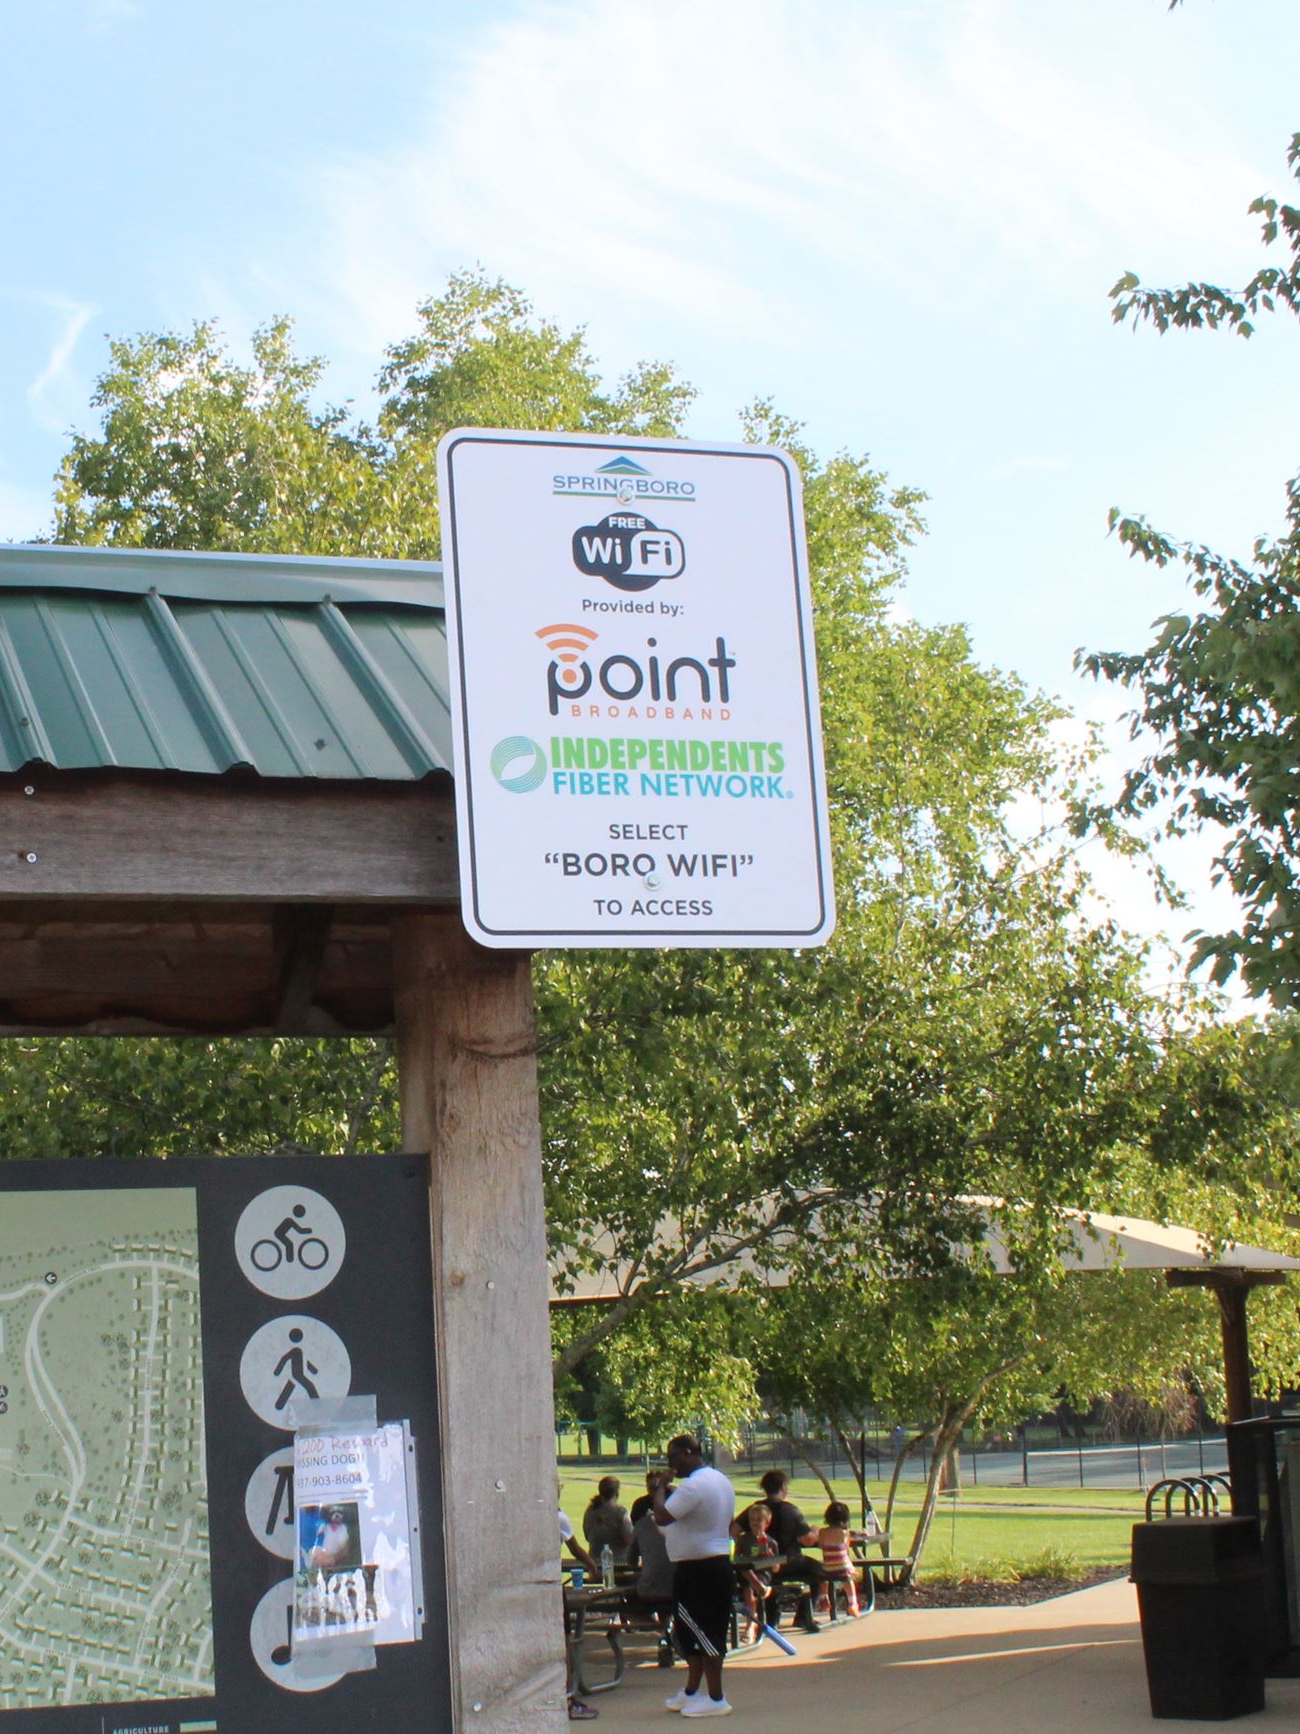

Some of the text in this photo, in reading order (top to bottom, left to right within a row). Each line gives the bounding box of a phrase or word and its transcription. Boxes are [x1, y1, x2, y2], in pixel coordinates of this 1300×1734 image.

[552, 475, 696, 496] SPRINGBORO
[608, 516, 647, 530] FREE
[582, 599, 685, 617] Provided by:
[547, 636, 736, 716] point
[571, 704, 732, 721] BROADBAND
[550, 736, 785, 774] INDEPENDENTS
[552, 771, 631, 796] FIBER
[608, 824, 689, 841] SELECT
[593, 900, 714, 916] TO ACCESS
[299, 1455, 328, 1468] SSING
[297, 1473, 363, 1488] 37-903-8604
